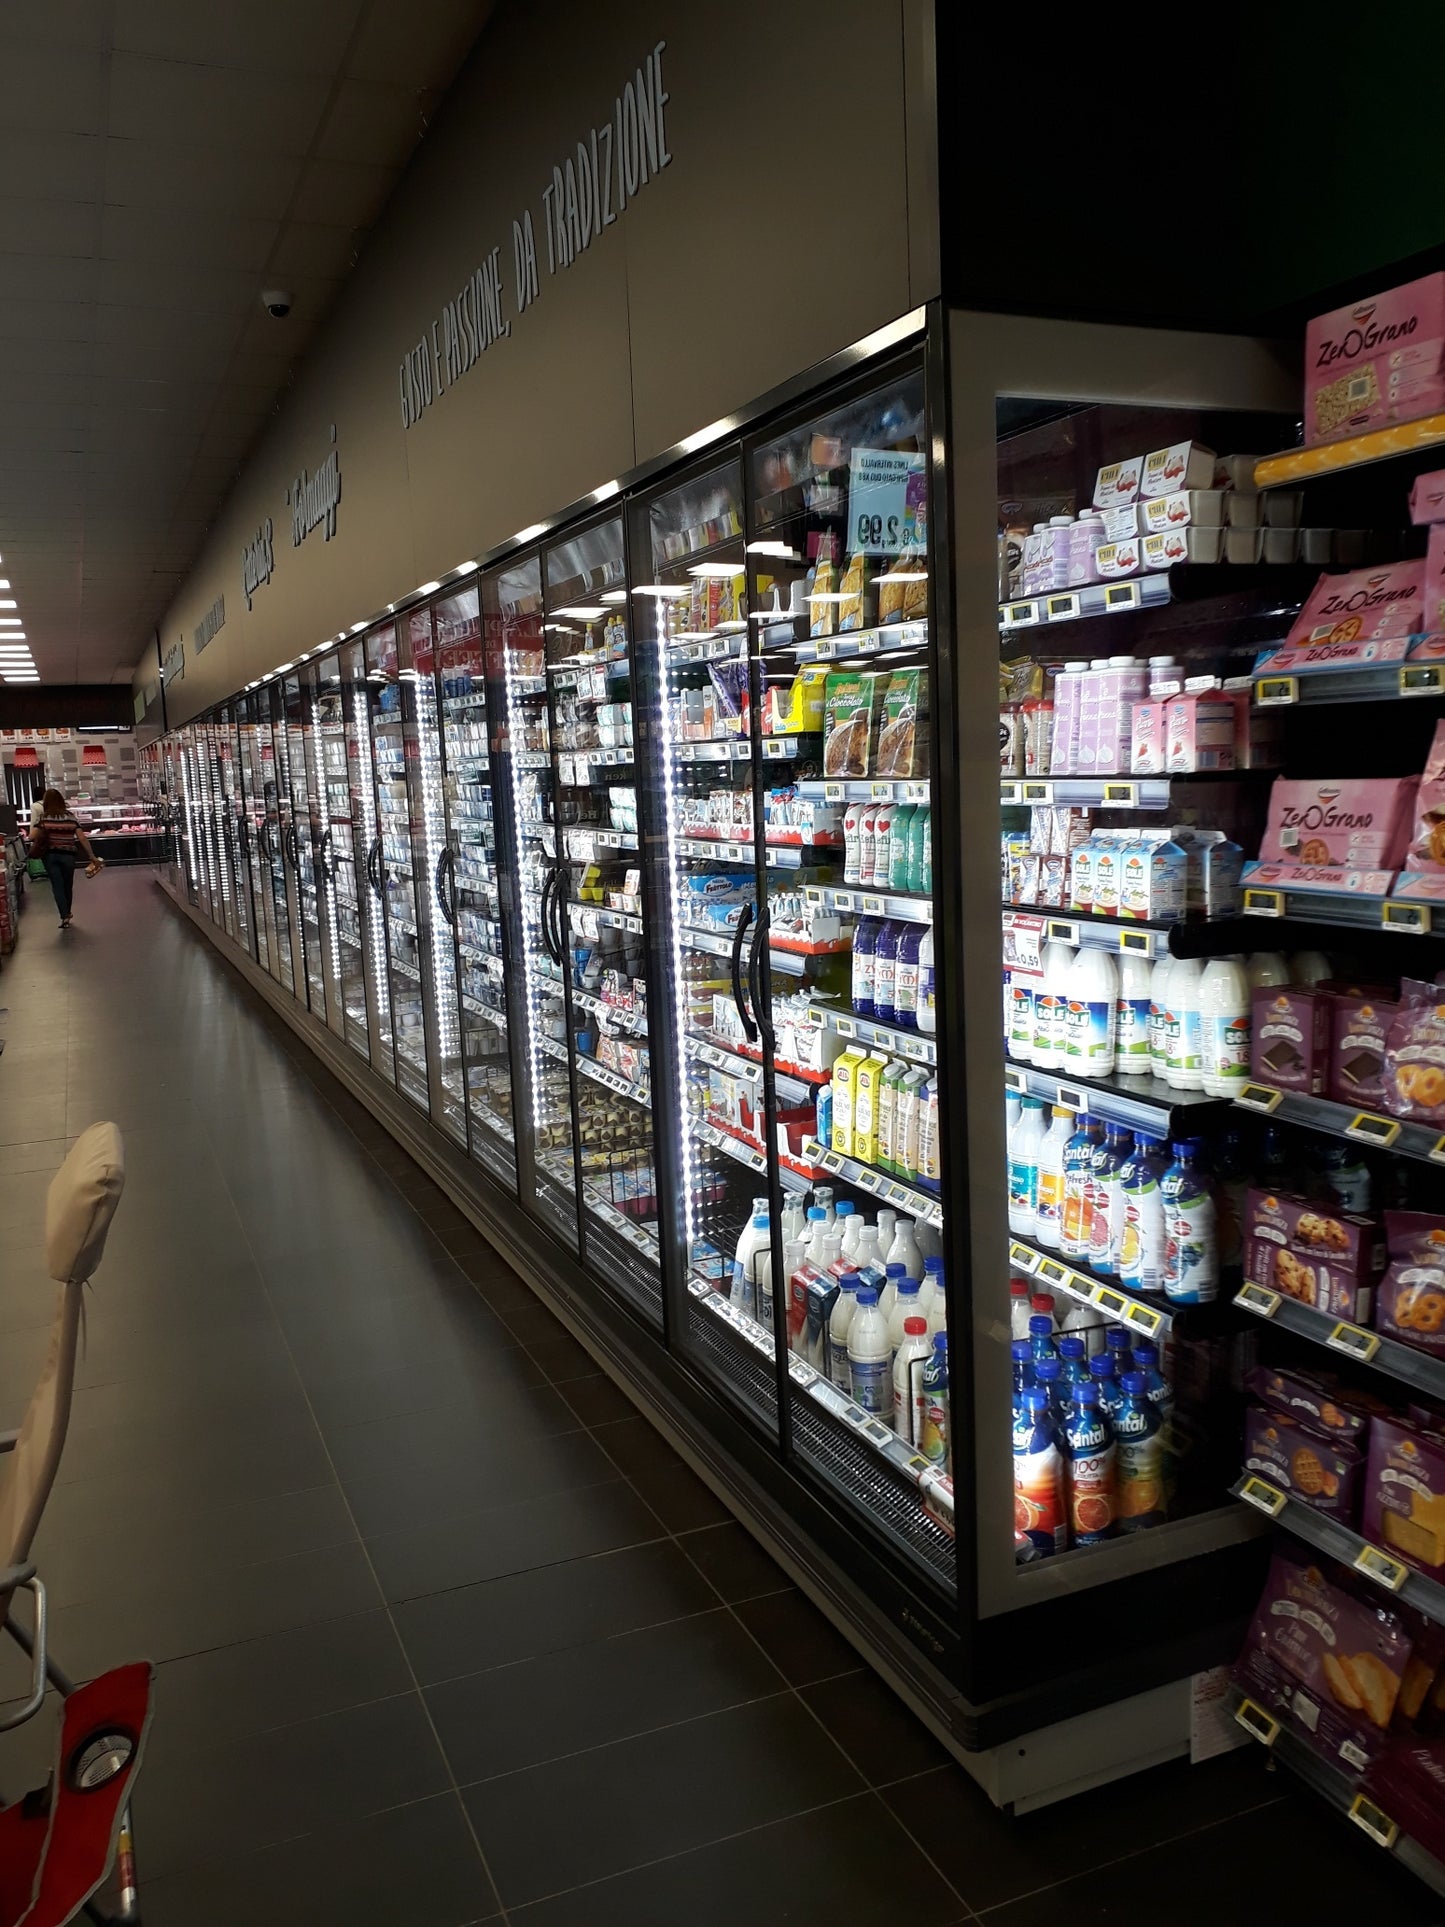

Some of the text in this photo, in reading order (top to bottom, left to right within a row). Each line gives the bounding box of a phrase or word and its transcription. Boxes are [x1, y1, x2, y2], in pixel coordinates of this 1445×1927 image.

[400, 335, 433, 429] GUSTO
[432, 320, 444, 397] E
[513, 209, 540, 313] DA
[542, 40, 673, 275] TRADIZIONE
[1075, 863, 1091, 874] SOLE
[1098, 865, 1114, 876] SOLE
[1126, 867, 1143, 878] SOLE
[1037, 1006, 1065, 1020] SOLE
[1112, 1413, 1146, 1433] antal
[1066, 1424, 1105, 1450] Santal
